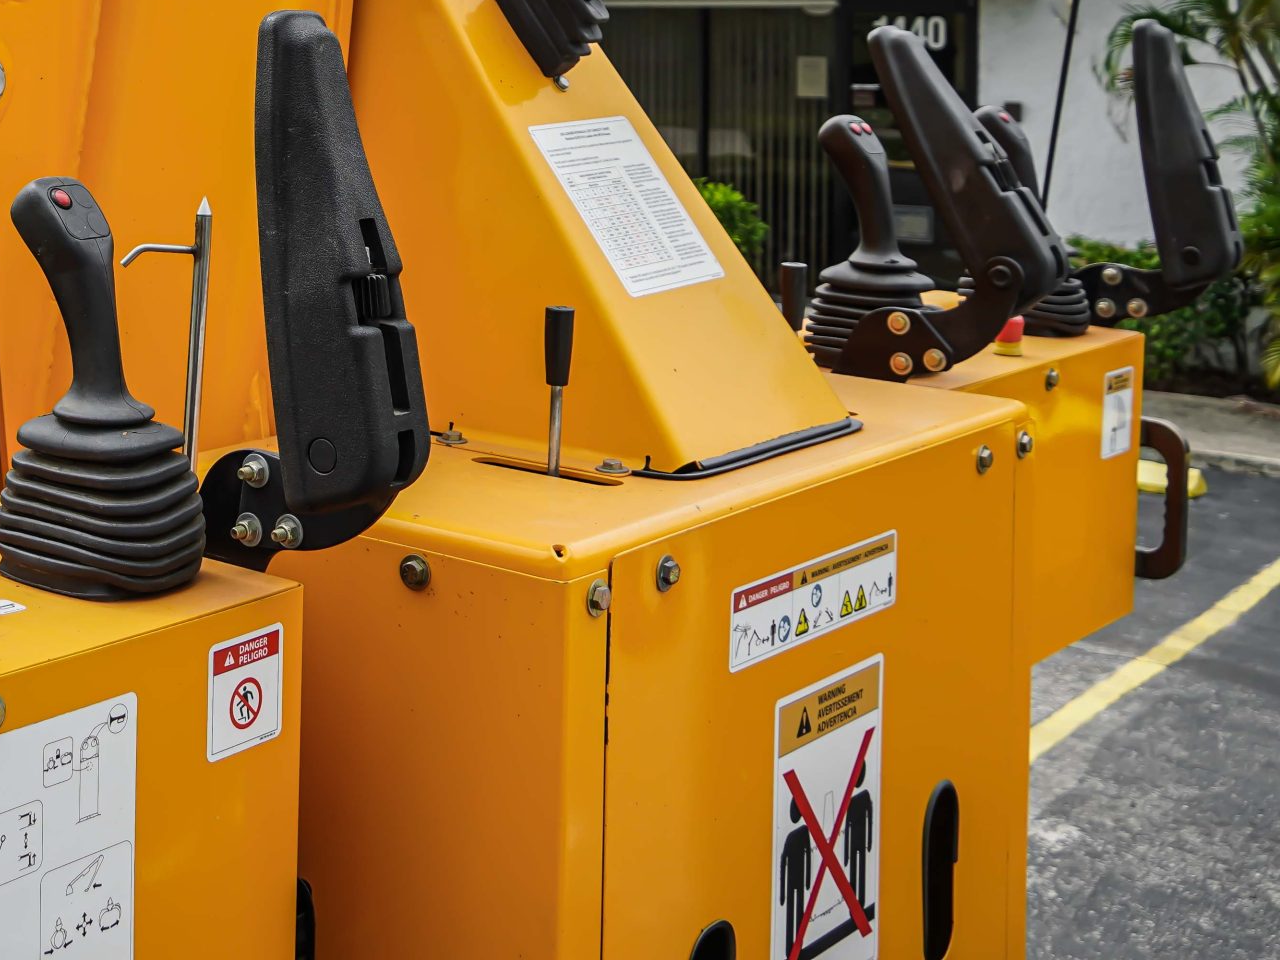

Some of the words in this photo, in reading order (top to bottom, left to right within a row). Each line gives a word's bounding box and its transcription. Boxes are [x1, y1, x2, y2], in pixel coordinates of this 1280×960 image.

[748, 586, 769, 603] DANGER
[770, 580, 790, 595] PELIGRO
[811, 567, 830, 579] WARNING
[239, 636, 268, 655] DANGER
[239, 647, 268, 665] PELIGRO
[817, 683, 846, 705] WARNING
[817, 688, 863, 720] AVERTISSEMENT
[817, 705, 857, 734] ADVERTENCIA
